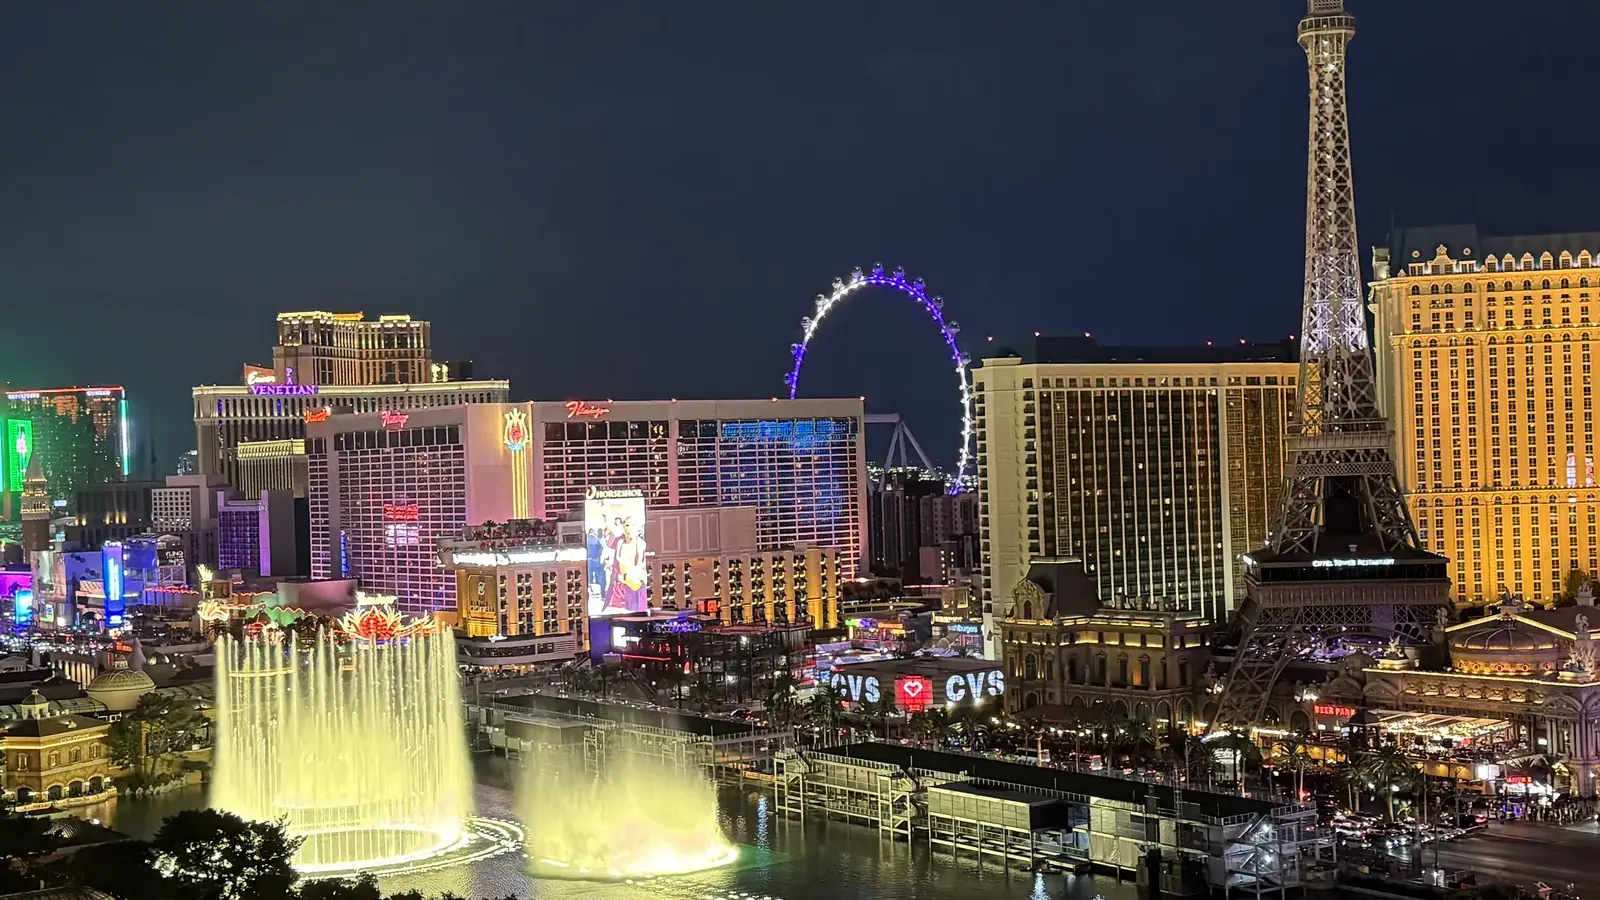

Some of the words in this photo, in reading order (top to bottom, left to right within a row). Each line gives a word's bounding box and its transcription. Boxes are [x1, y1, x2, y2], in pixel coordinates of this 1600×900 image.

[250, 386, 316, 395] VENETIAN
[831, 673, 881, 703] CVS
[946, 670, 1005, 702] CVS
